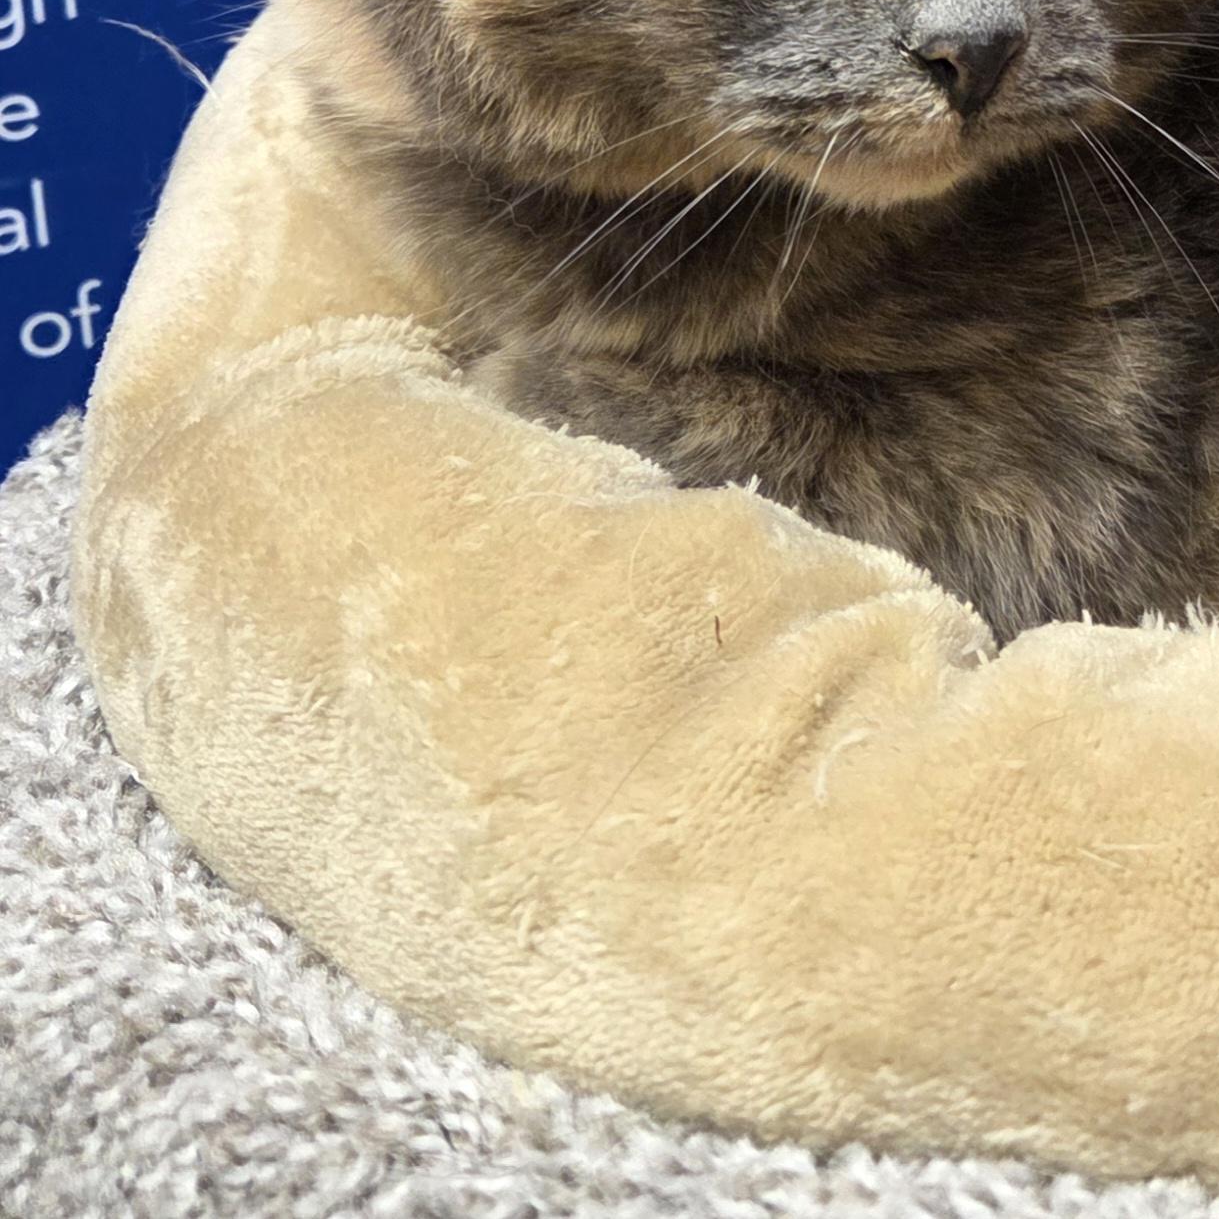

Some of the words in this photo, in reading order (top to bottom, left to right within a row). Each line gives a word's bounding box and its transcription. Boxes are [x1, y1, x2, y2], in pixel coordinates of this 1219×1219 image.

[0, 94, 40, 141] e
[0, 178, 50, 255] al
[20, 278, 102, 358] of
